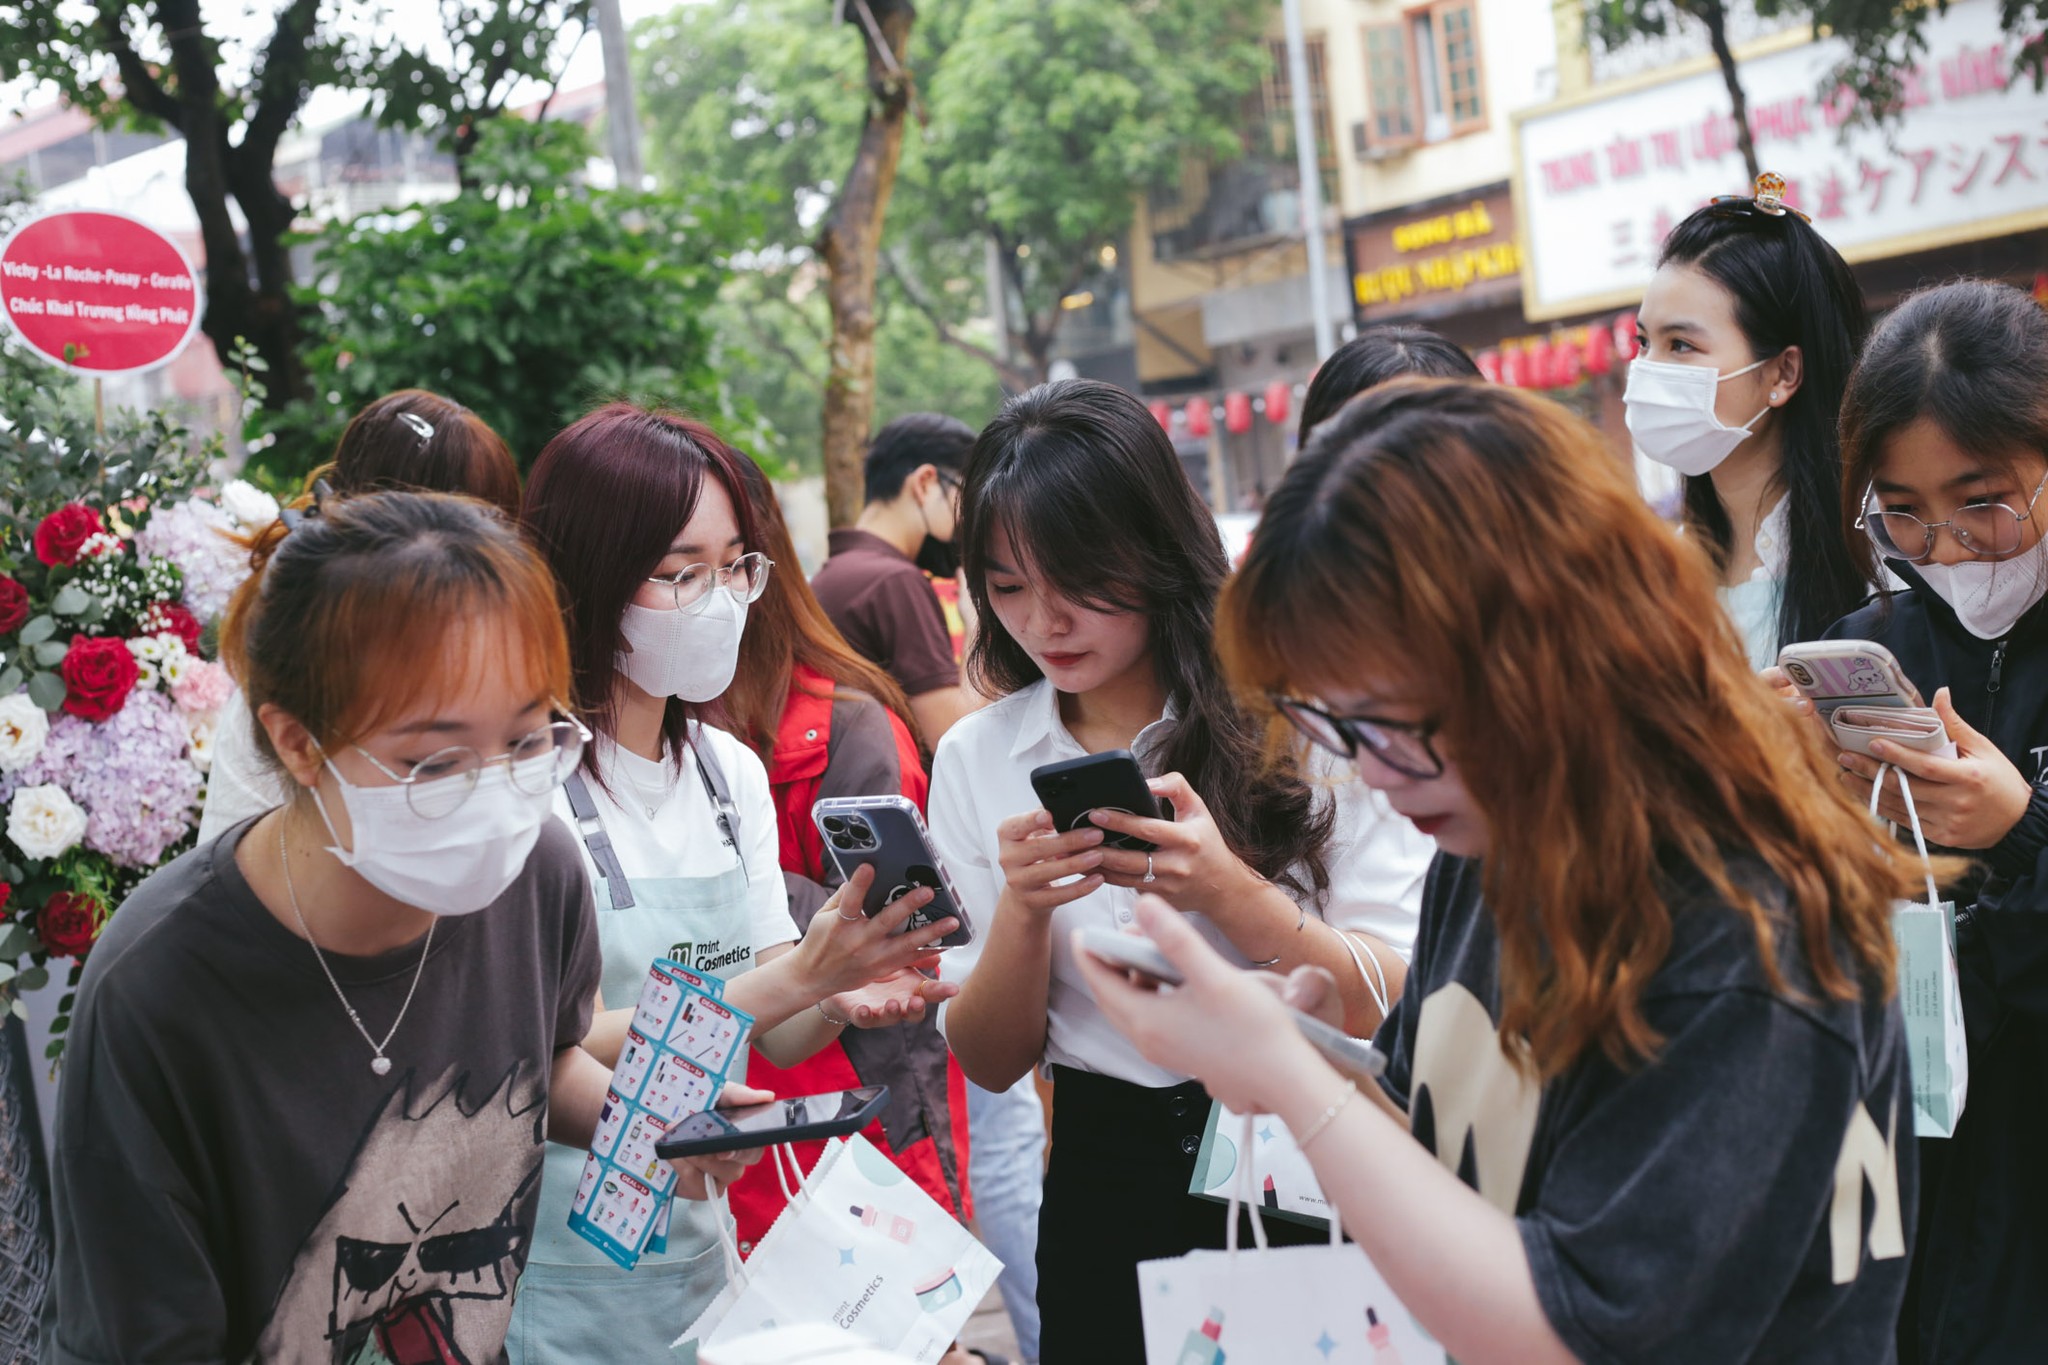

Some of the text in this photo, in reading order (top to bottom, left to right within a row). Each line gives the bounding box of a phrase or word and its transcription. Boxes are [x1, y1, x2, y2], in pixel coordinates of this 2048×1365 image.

[2, 261, 38, 281] Vichy
[10, 296, 44, 315] Chúc
[46, 298, 75, 317] Khai
[696, 939, 720, 955] mint
[695, 946, 751, 972] Cosmetics
[647, 1115, 665, 1130] DEAL
[621, 1173, 638, 1189] DEAL
[832, 1300, 851, 1323] mint
[840, 1274, 884, 1330] Cosmetics
